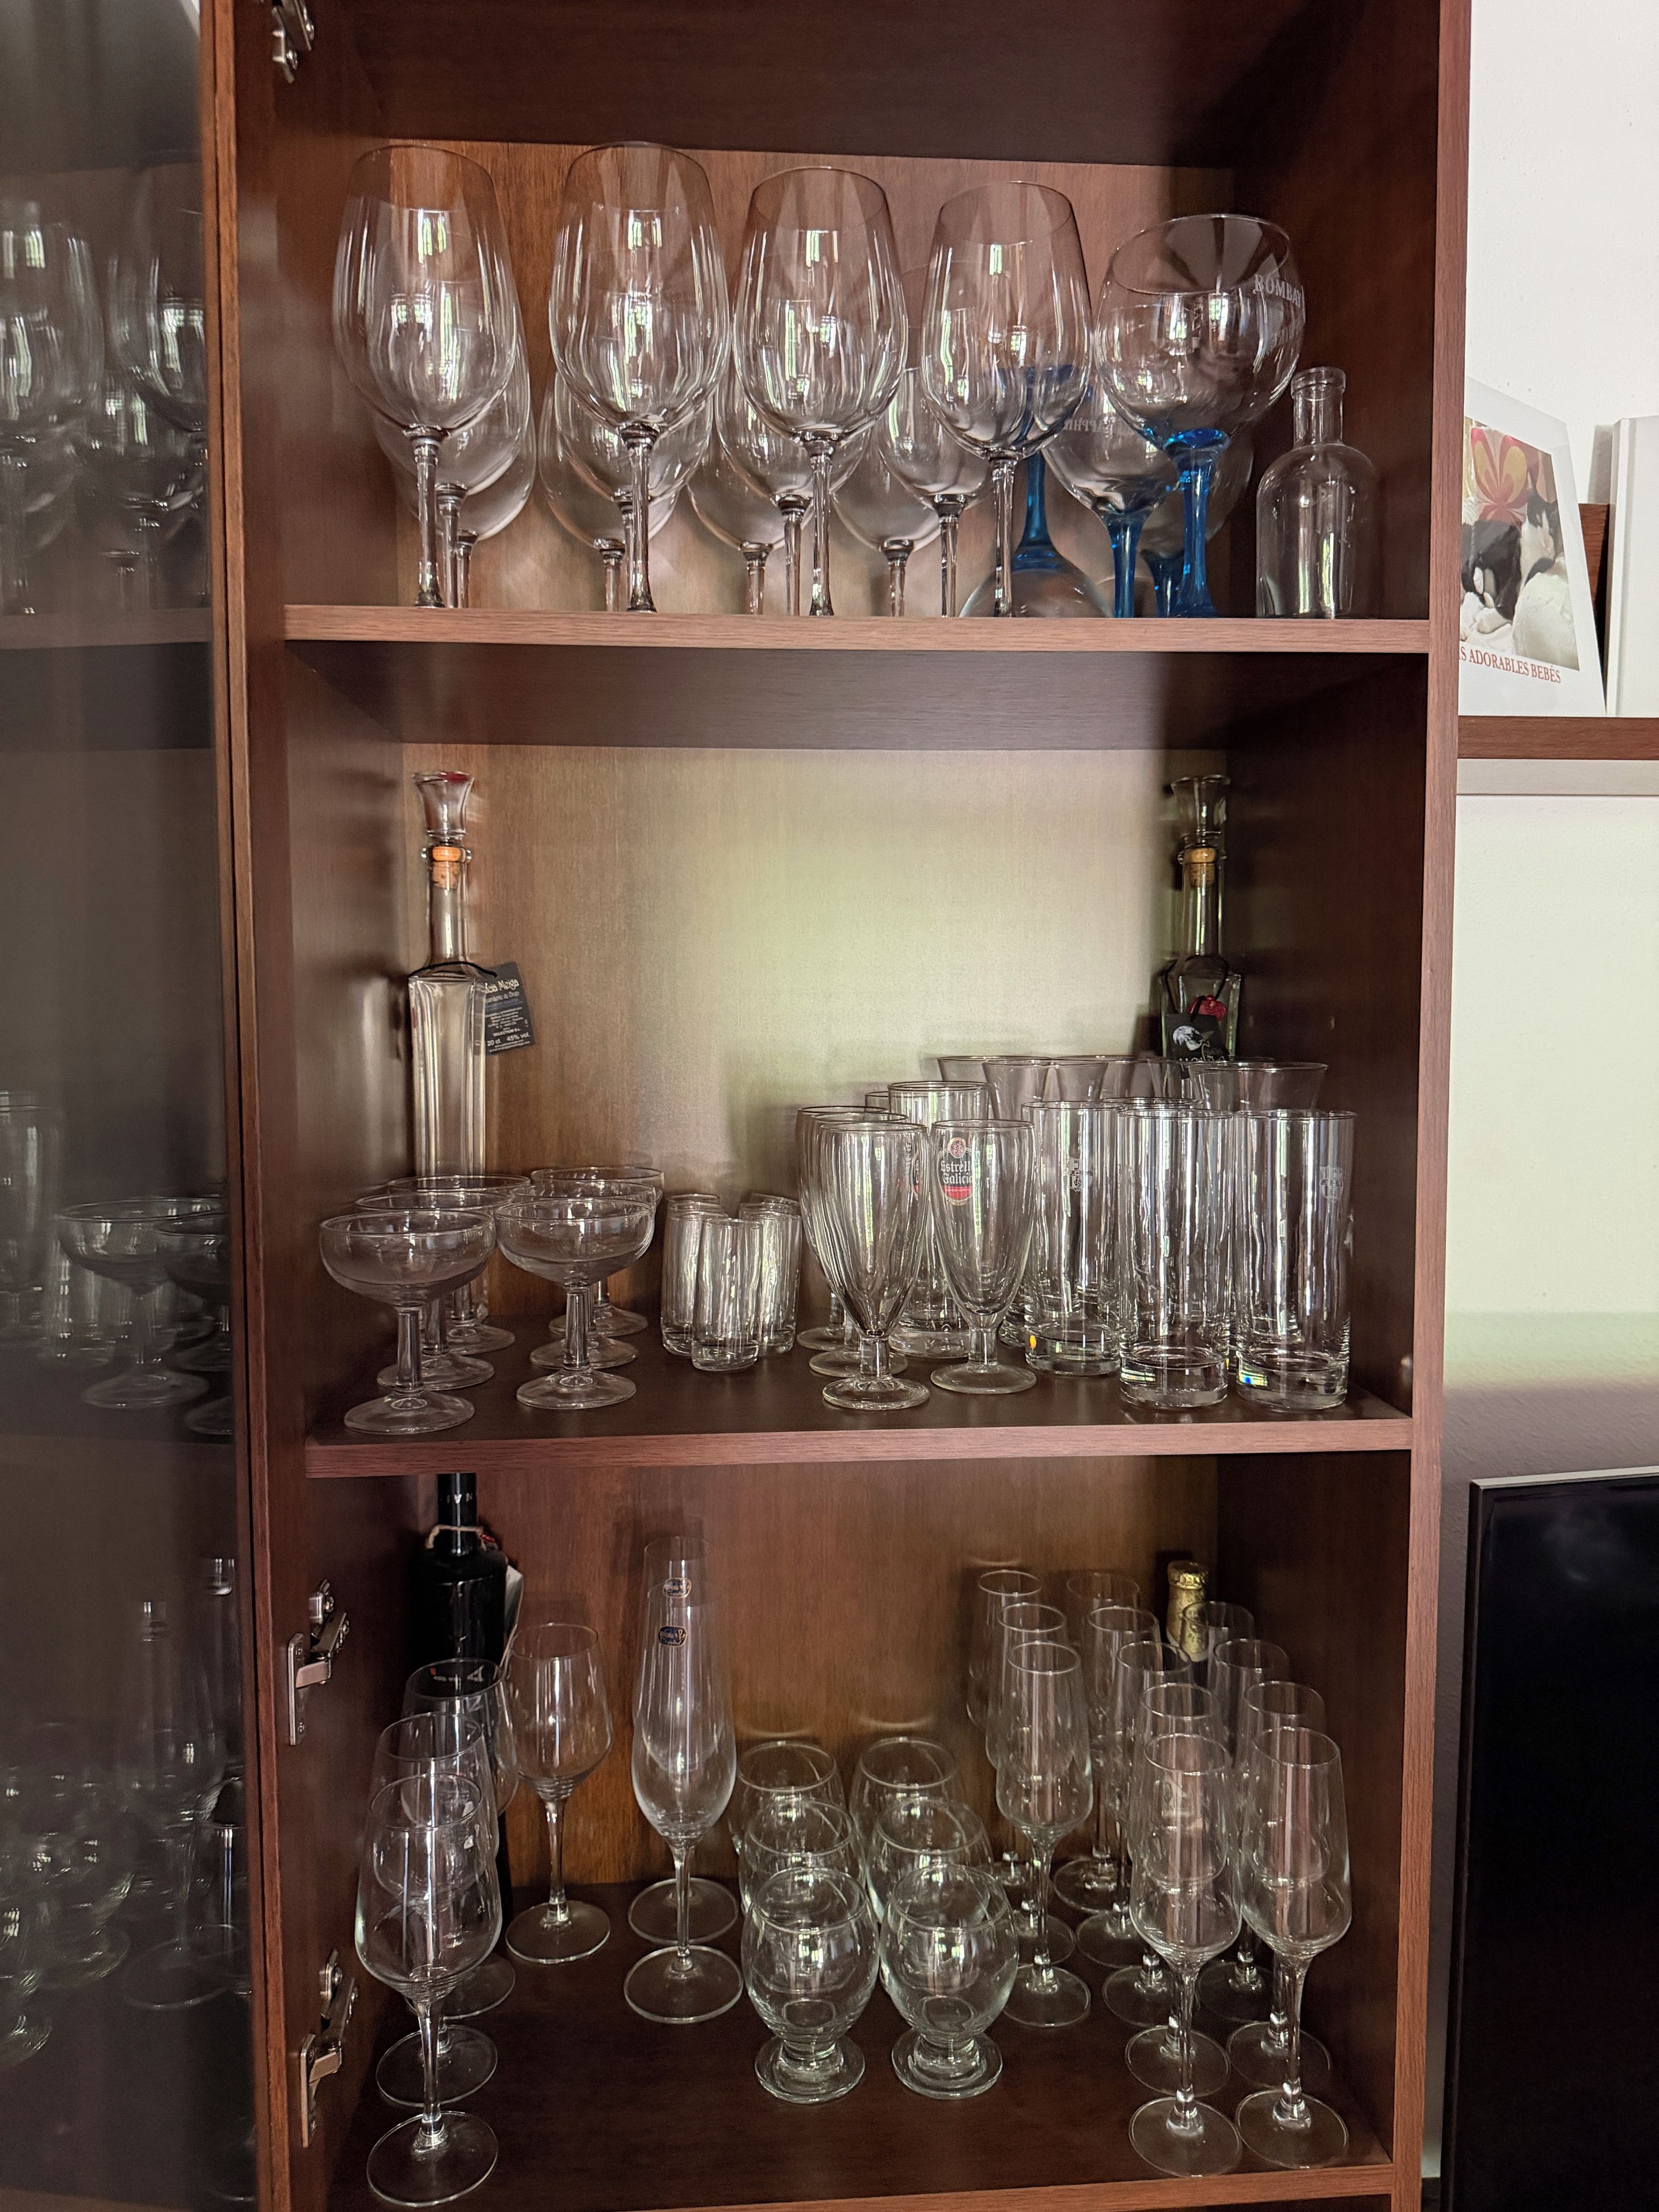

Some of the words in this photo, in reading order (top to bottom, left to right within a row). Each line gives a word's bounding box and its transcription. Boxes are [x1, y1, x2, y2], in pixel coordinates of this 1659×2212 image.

[1459, 646, 1467, 661] S
[1469, 649, 1529, 676] ADORABLES
[1530, 664, 1560, 684] BEBÉS
[941, 1160, 974, 1173] Estrell
